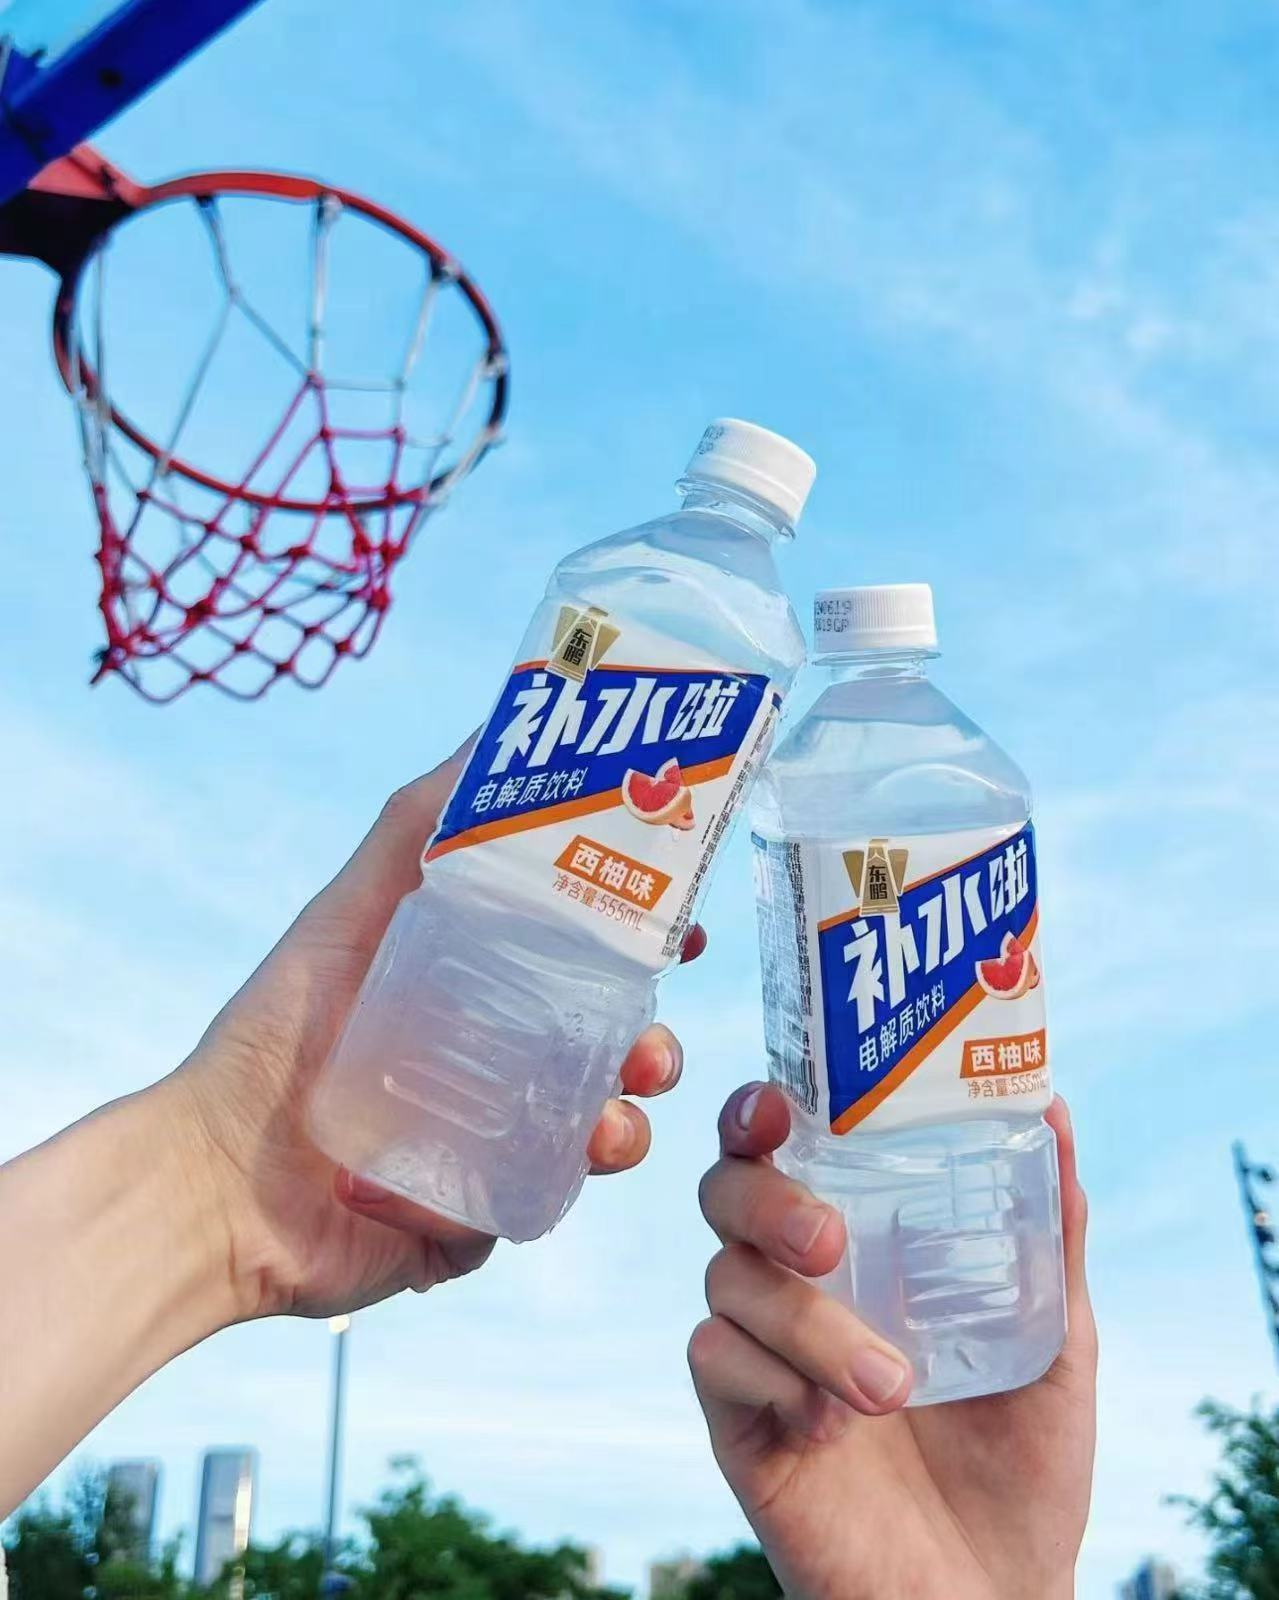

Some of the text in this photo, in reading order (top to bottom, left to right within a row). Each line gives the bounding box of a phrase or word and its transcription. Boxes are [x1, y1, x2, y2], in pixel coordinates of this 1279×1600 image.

[562, 628, 592, 666] 东鹏
[488, 673, 742, 776] 补水啦
[470, 767, 589, 814] 电解质饮料
[569, 842, 656, 901] 西柚味
[868, 865, 888, 900] 东鹏
[843, 839, 1029, 1034] 补水啦
[858, 979, 946, 1073] 电解质饮料
[970, 1037, 1042, 1073] 西柚味
